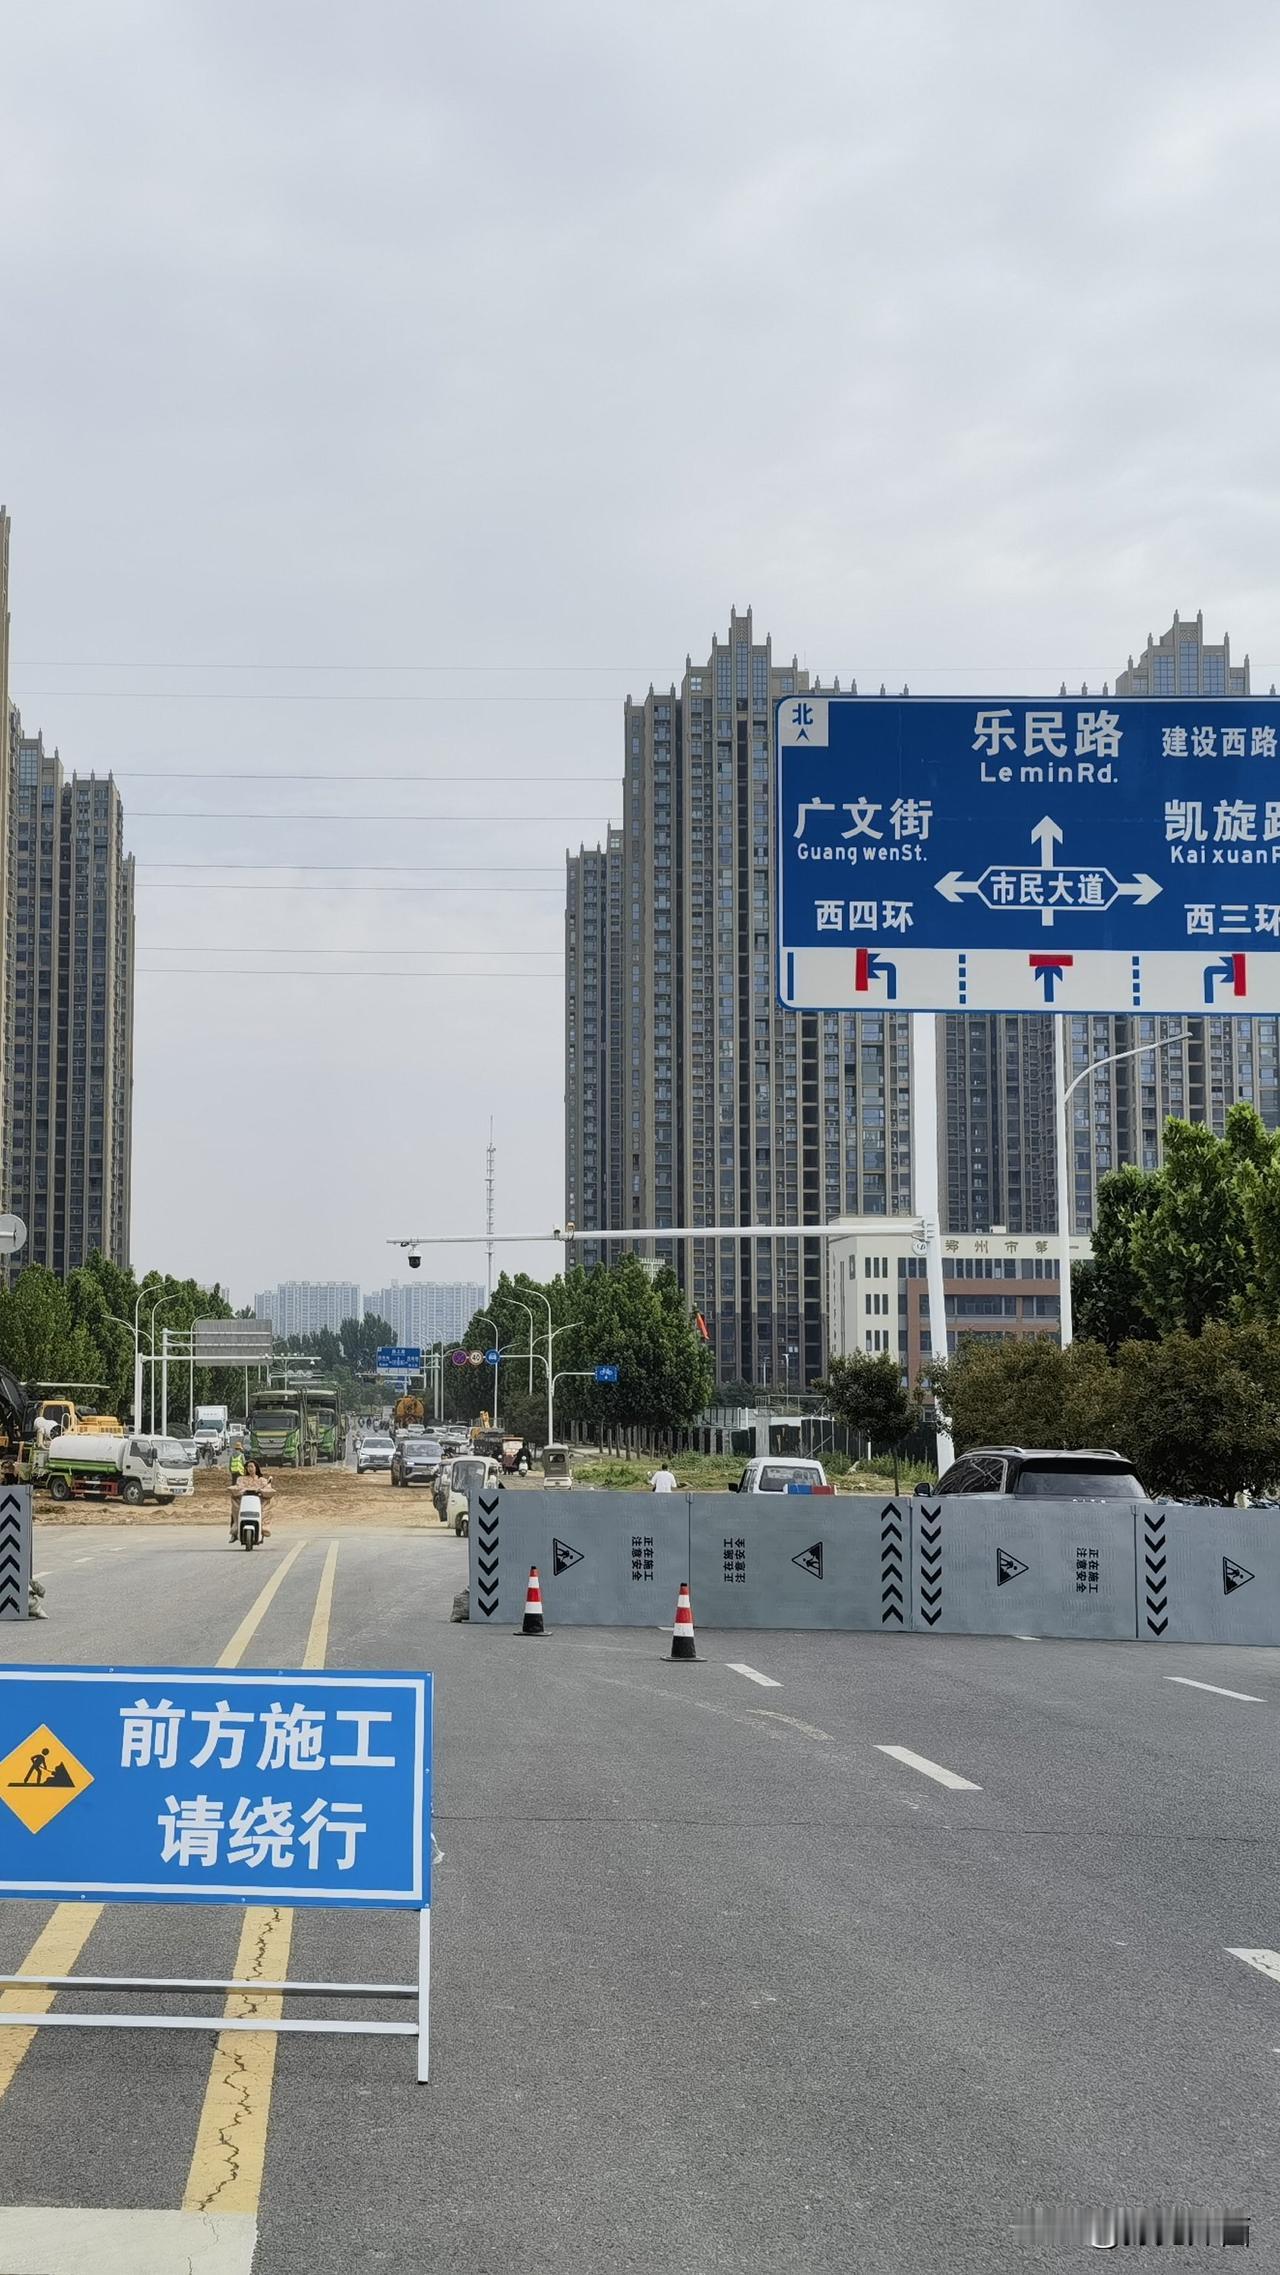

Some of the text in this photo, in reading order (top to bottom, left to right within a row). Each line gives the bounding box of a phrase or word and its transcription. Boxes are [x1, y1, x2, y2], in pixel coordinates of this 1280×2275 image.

[792, 703, 813, 726] 北
[972, 709, 1123, 758] 乐民路
[1161, 725, 1278, 758] 建设西路
[793, 796, 933, 841] 广文街
[991, 872, 1105, 904] 市民大道
[814, 900, 914, 933] 西四环
[1183, 903, 1280, 937] 西三环
[631, 1536, 643, 1582] 注意安全
[643, 1536, 654, 1582] 正在施工
[723, 1537, 734, 1583] 正在施工
[734, 1538, 746, 1583] 注意安全
[1076, 1547, 1088, 1593] 注意安全
[1088, 1547, 1099, 1594] 正在施工
[120, 1698, 396, 1771] 前方施工
[157, 1794, 367, 1870] 请绕行
